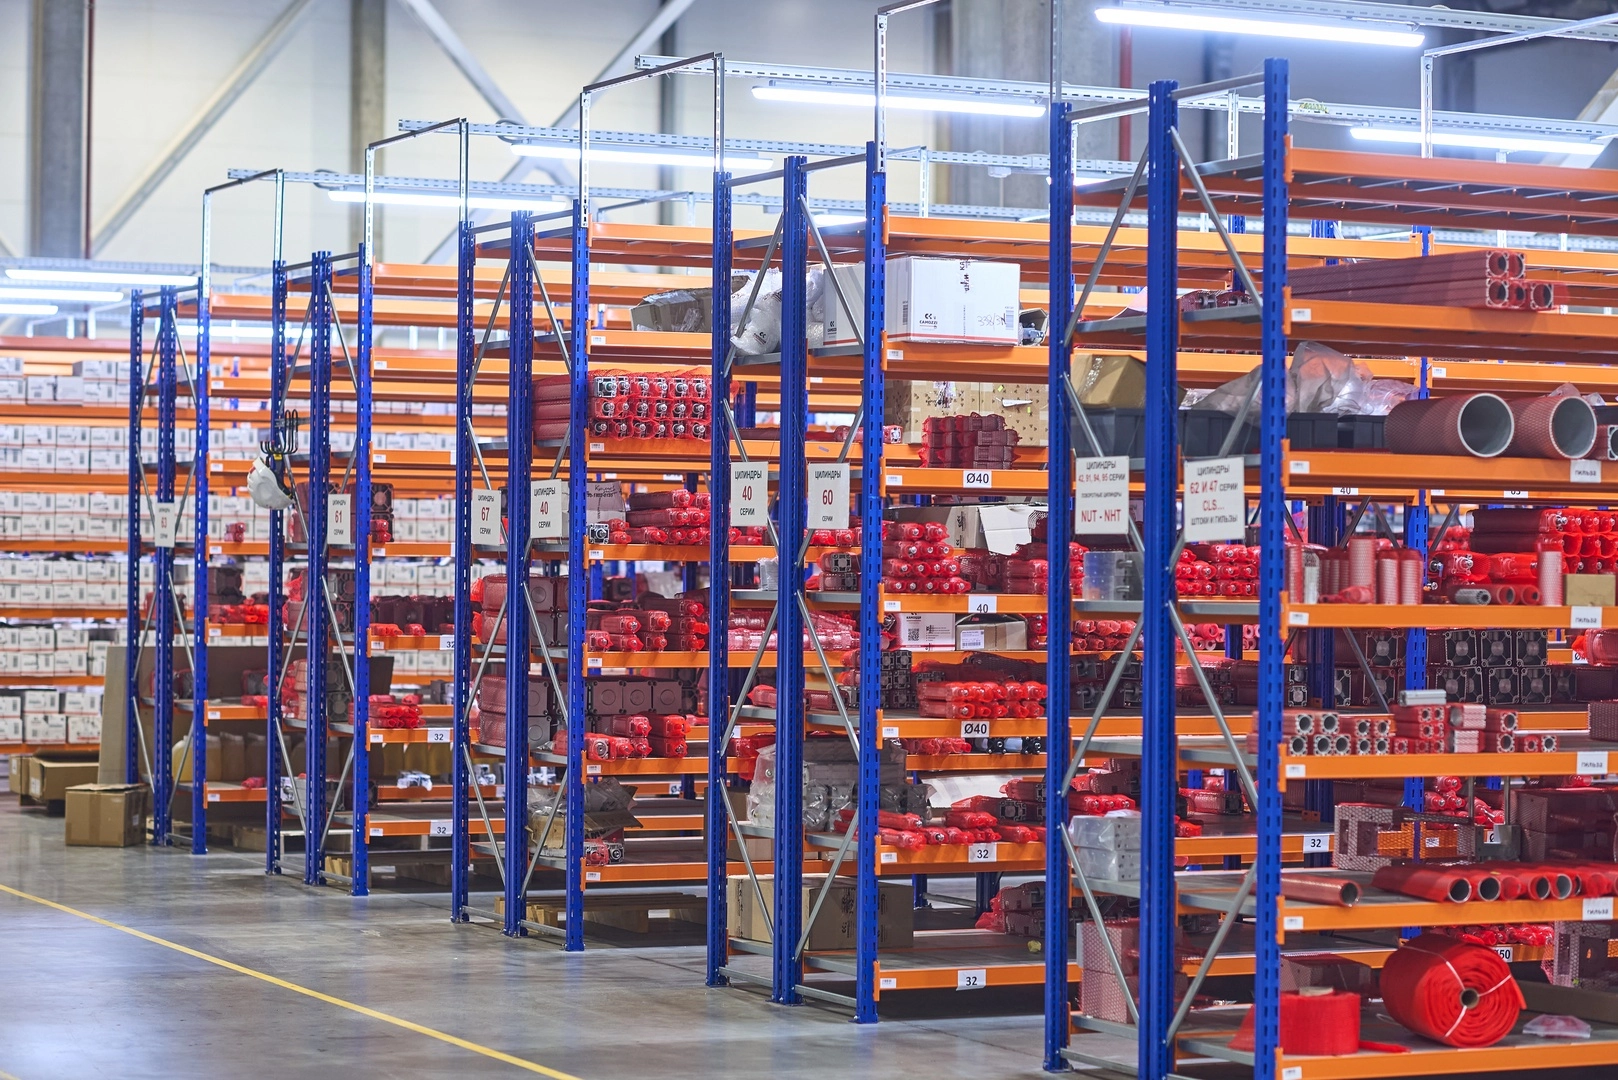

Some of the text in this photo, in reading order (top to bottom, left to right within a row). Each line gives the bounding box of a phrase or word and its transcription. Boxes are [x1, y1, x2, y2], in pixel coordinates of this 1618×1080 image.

[734, 470, 762, 480] ЦИЛИНДРЫ
[815, 470, 841, 480] ЦИЛИНДРЫ
[966, 472, 989, 484] Ø40
[1209, 480, 1218, 492] 47
[742, 485, 752, 501] 40
[822, 489, 833, 505] 60
[481, 507, 490, 521] 67
[540, 501, 549, 515] 40
[740, 508, 755, 516] СЕРИИ
[334, 510, 343, 524] 61
[1081, 510, 1097, 522] NUT
[1104, 509, 1121, 522] NHT
[976, 604, 988, 613] 40
[964, 723, 987, 735] Ø40
[434, 733, 444, 741] 32
[1311, 838, 1322, 848] 32
[977, 849, 989, 859] 32
[966, 976, 977, 986] 32
